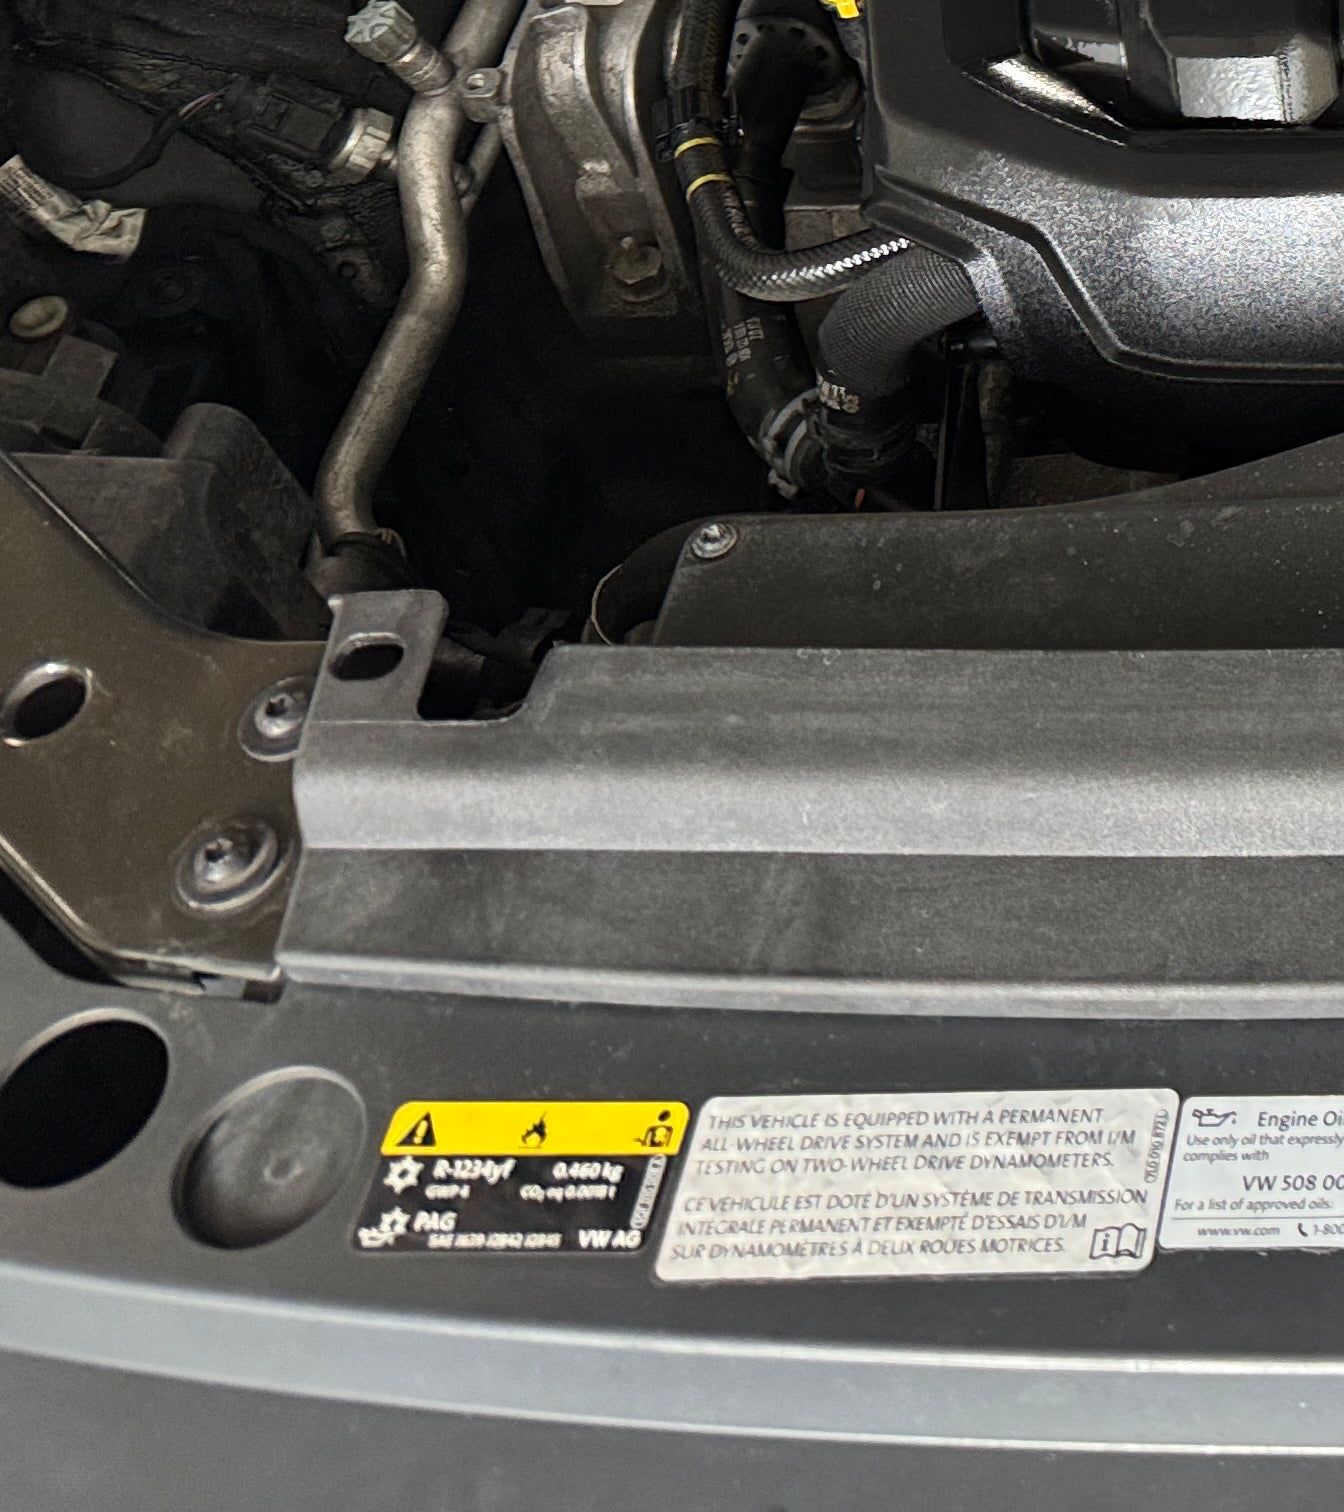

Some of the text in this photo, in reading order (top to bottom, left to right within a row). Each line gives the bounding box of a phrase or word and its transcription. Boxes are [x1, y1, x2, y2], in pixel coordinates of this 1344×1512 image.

[708, 1108, 1104, 1131] THIS VEHICLE IS EQUIPPED WITH A PERMANENT
[1257, 1110, 1319, 1131] Engine
[800, 1130, 1103, 1150] DRIVE SYSTEM AND IS EXEMPT FROM
[1186, 1134, 1209, 1146] Use
[1212, 1133, 1239, 1148] only
[1241, 1133, 1257, 1146] oil
[1259, 1133, 1285, 1146] that
[1287, 1133, 1344, 1147] expressly
[695, 1152, 1114, 1175] TESTING ON DRIVE DYNAMOMETERS.
[1183, 1150, 1238, 1164] complies
[1242, 1149, 1270, 1161] with
[1242, 1174, 1277, 1191] VW
[1281, 1174, 1317, 1191] 508
[683, 1188, 1149, 1212] CE EST DE TRANSMISSION
[1174, 1197, 1194, 1210] For
[1197, 1198, 1205, 1210] a
[1208, 1197, 1228, 1210] list
[1229, 1197, 1244, 1210] of
[1246, 1197, 1307, 1213] approved
[413, 1210, 458, 1232] PAG
[769, 1216, 891, 1234] PERMANENT ET
[578, 1230, 609, 1248] VW
[612, 1230, 642, 1248] AG
[671, 1238, 977, 1260] SUR DEUX ROUES
